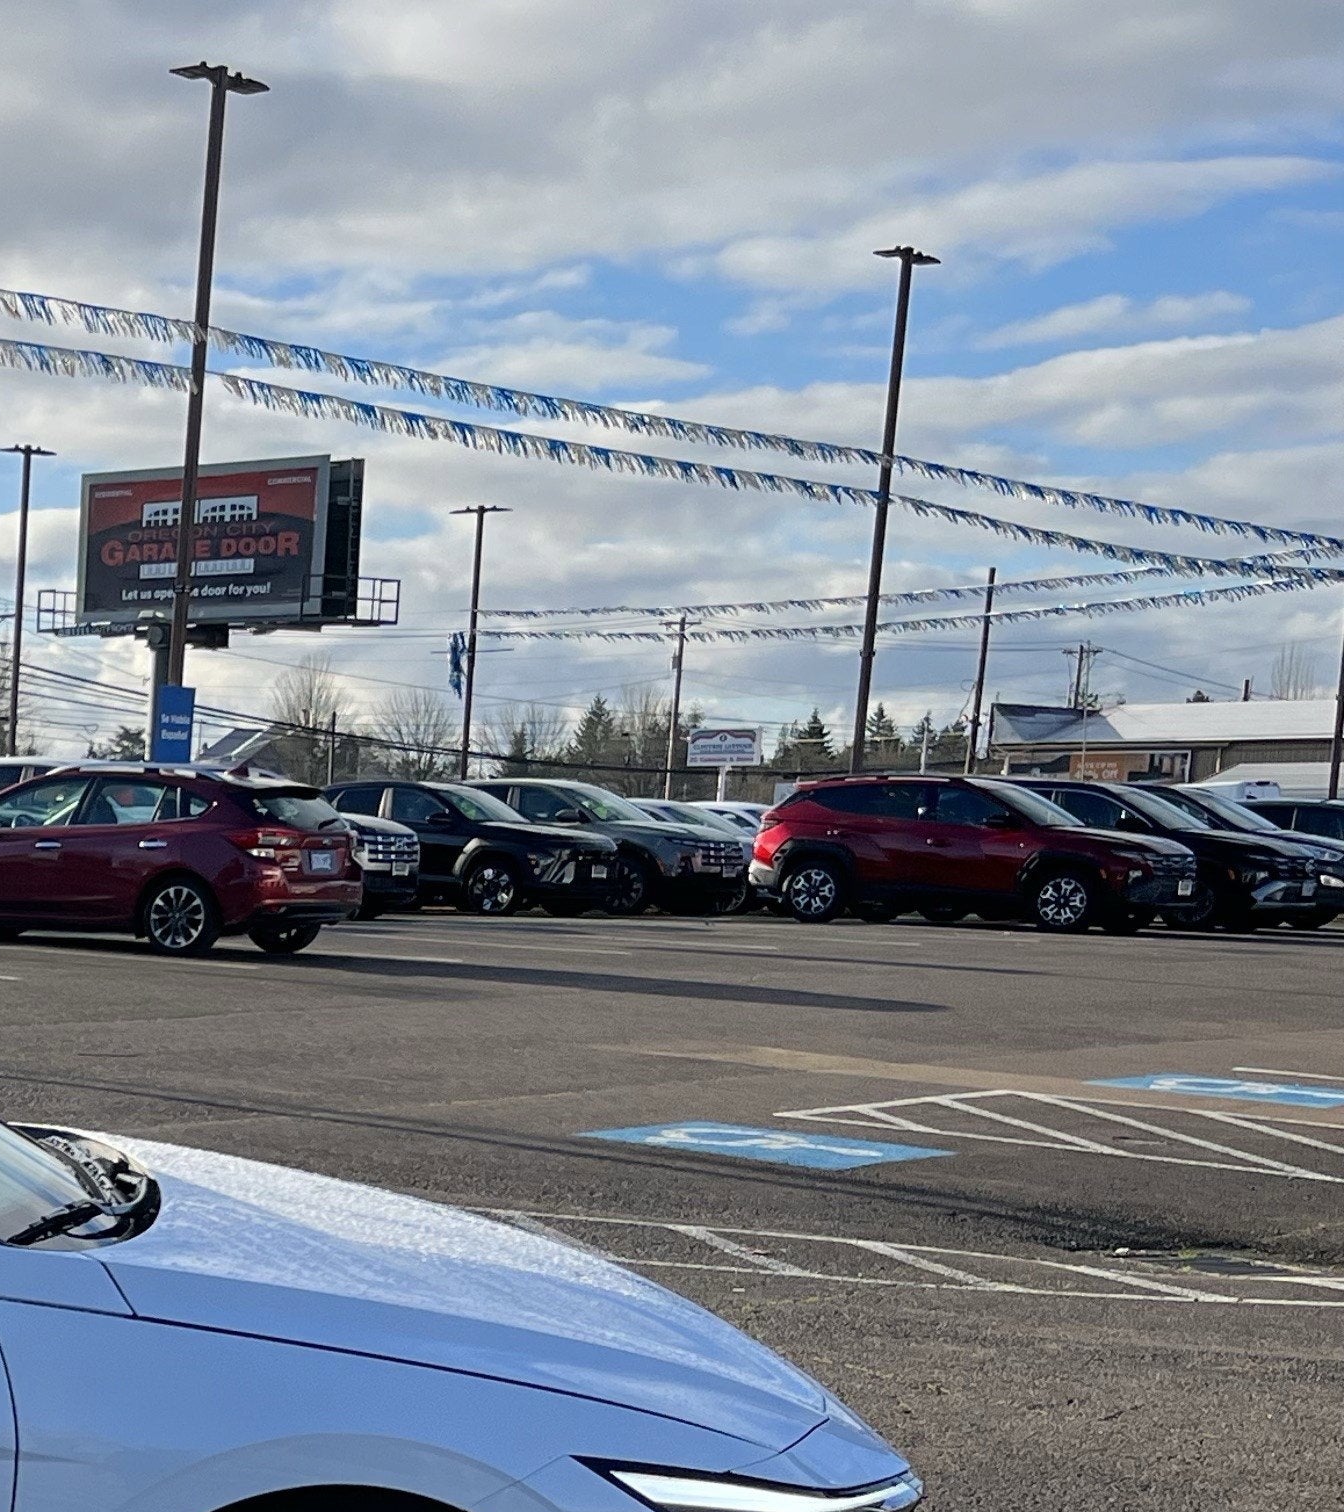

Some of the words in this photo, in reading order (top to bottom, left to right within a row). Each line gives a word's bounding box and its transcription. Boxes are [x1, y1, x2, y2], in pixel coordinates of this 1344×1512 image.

[226, 522, 276, 536] CITY
[101, 539, 211, 567] GARAE
[220, 531, 299, 557] DOOR
[122, 589, 138, 600] Let
[140, 590, 152, 599] us
[154, 589, 176, 601] ope
[201, 584, 227, 596] door
[228, 583, 245, 595] for
[245, 582, 271, 597] you!
